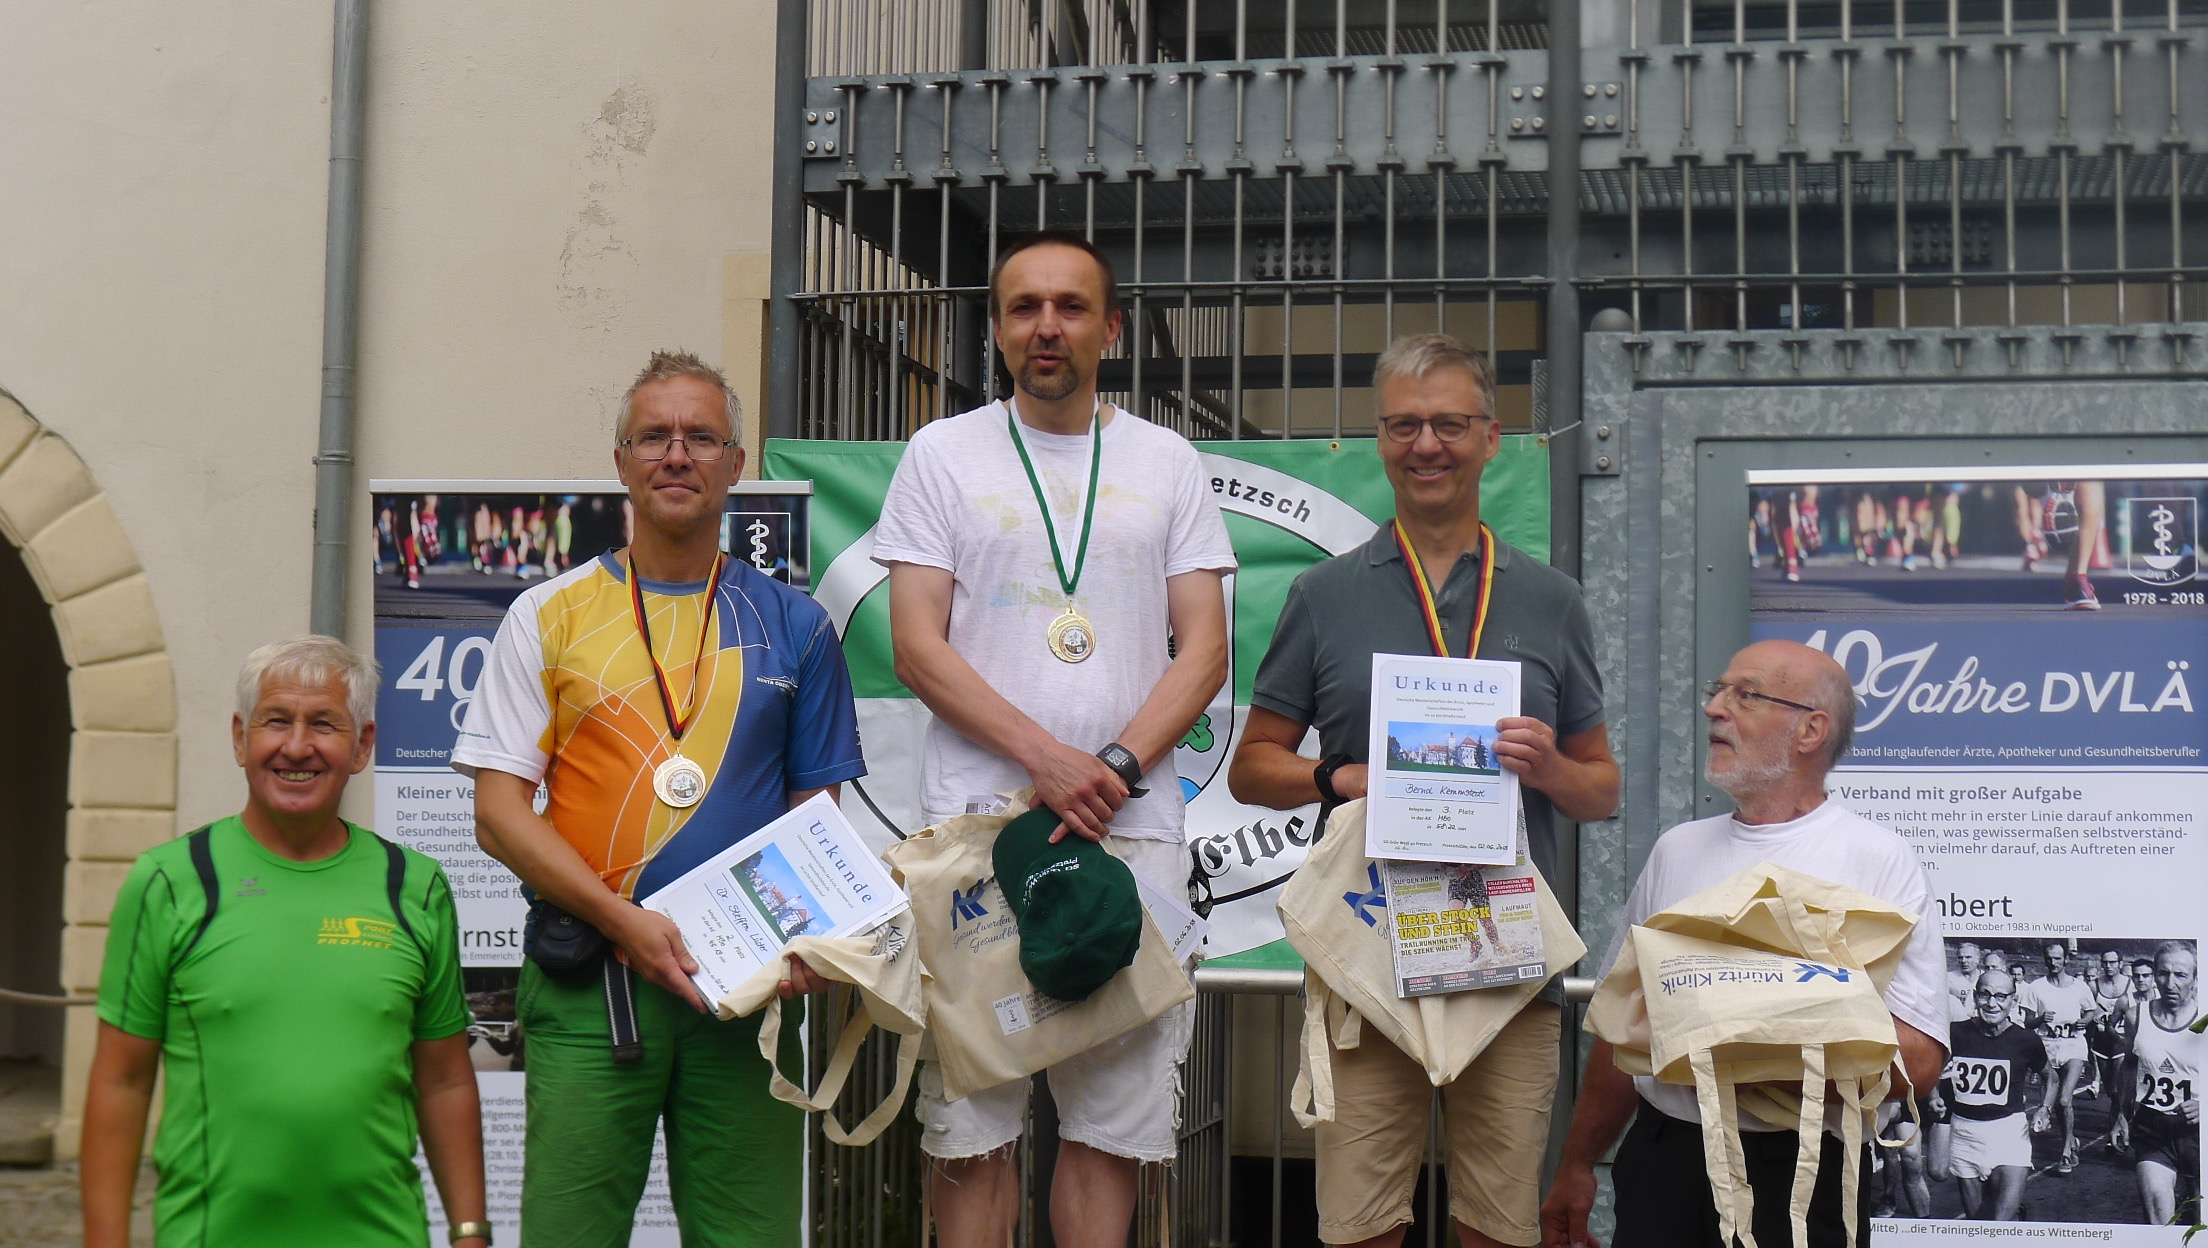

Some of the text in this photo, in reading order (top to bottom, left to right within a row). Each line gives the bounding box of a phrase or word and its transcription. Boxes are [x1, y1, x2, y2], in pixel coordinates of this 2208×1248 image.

[2123, 592, 2157, 604] 1978
[2171, 592, 2205, 604] 2018
[1395, 675, 1498, 694] Urkunde
[1855, 641, 2031, 733] Jahre
[2039, 660, 2194, 713] DVLÄ
[396, 747, 448, 758] Deutscher
[1884, 746, 1960, 759] langlaufender
[1963, 744, 1995, 758] Ärzte,
[1998, 746, 2056, 759] Apotheker
[2059, 746, 2082, 757] und
[2084, 745, 2200, 757] Gesundheitsberufler
[397, 786, 452, 799] Kleiner
[1840, 786, 1911, 800] Verband
[1916, 786, 1945, 800] mit
[1949, 786, 2007, 803] großer
[2011, 786, 2082, 803] Aufgabe
[396, 811, 418, 821] Der
[1876, 813, 1890, 821] es
[1894, 810, 1928, 821] nicht
[1931, 810, 1967, 821] mehr
[1970, 811, 1983, 821] in
[1987, 812, 2027, 821] erster
[2031, 810, 2063, 821] Linie
[2067, 810, 2113, 821] darauf
[2115, 810, 2193, 822] ankommen
[1943, 829, 1969, 838] was
[1972, 827, 2079, 840] gewissermaßen
[2083, 827, 2188, 838] selbstverständ-
[1928, 843, 1987, 854] vielmehr
[1991, 843, 2039, 856] darauf,
[2043, 843, 2067, 854] das
[2071, 843, 2136, 854] Auftreten
[2140, 844, 2175, 854] einer
[809, 820, 872, 903] Urkunde
[467, 873, 486, 883] die
[485, 888, 508, 899] und
[1396, 912, 1439, 927] ÜBER
[1441, 905, 1491, 923] STOCK
[1398, 926, 1431, 940] UND
[1433, 921, 1478, 937] STEIN
[1949, 922, 1963, 931] 10.
[1966, 922, 2004, 931] Oktober
[2007, 922, 2030, 931] 1983
[2032, 923, 2040, 931] in
[2043, 923, 2093, 933] Wuppertal
[317, 938, 393, 949] PROPHET
[463, 927, 518, 947] rnst
[1400, 938, 1448, 949] TRAILRUNNING
[1414, 946, 1434, 954] SZENE
[1661, 972, 1784, 996] Müritz Klinik
[1003, 996, 1021, 1008] Jahre
[1955, 1063, 2008, 1096] 320
[2141, 1073, 2191, 1107] 231
[1930, 1224, 2023, 1238] Trainingslegende
[2025, 1229, 2045, 1237] aus
[2048, 1227, 2113, 1240] Wittenberg!
